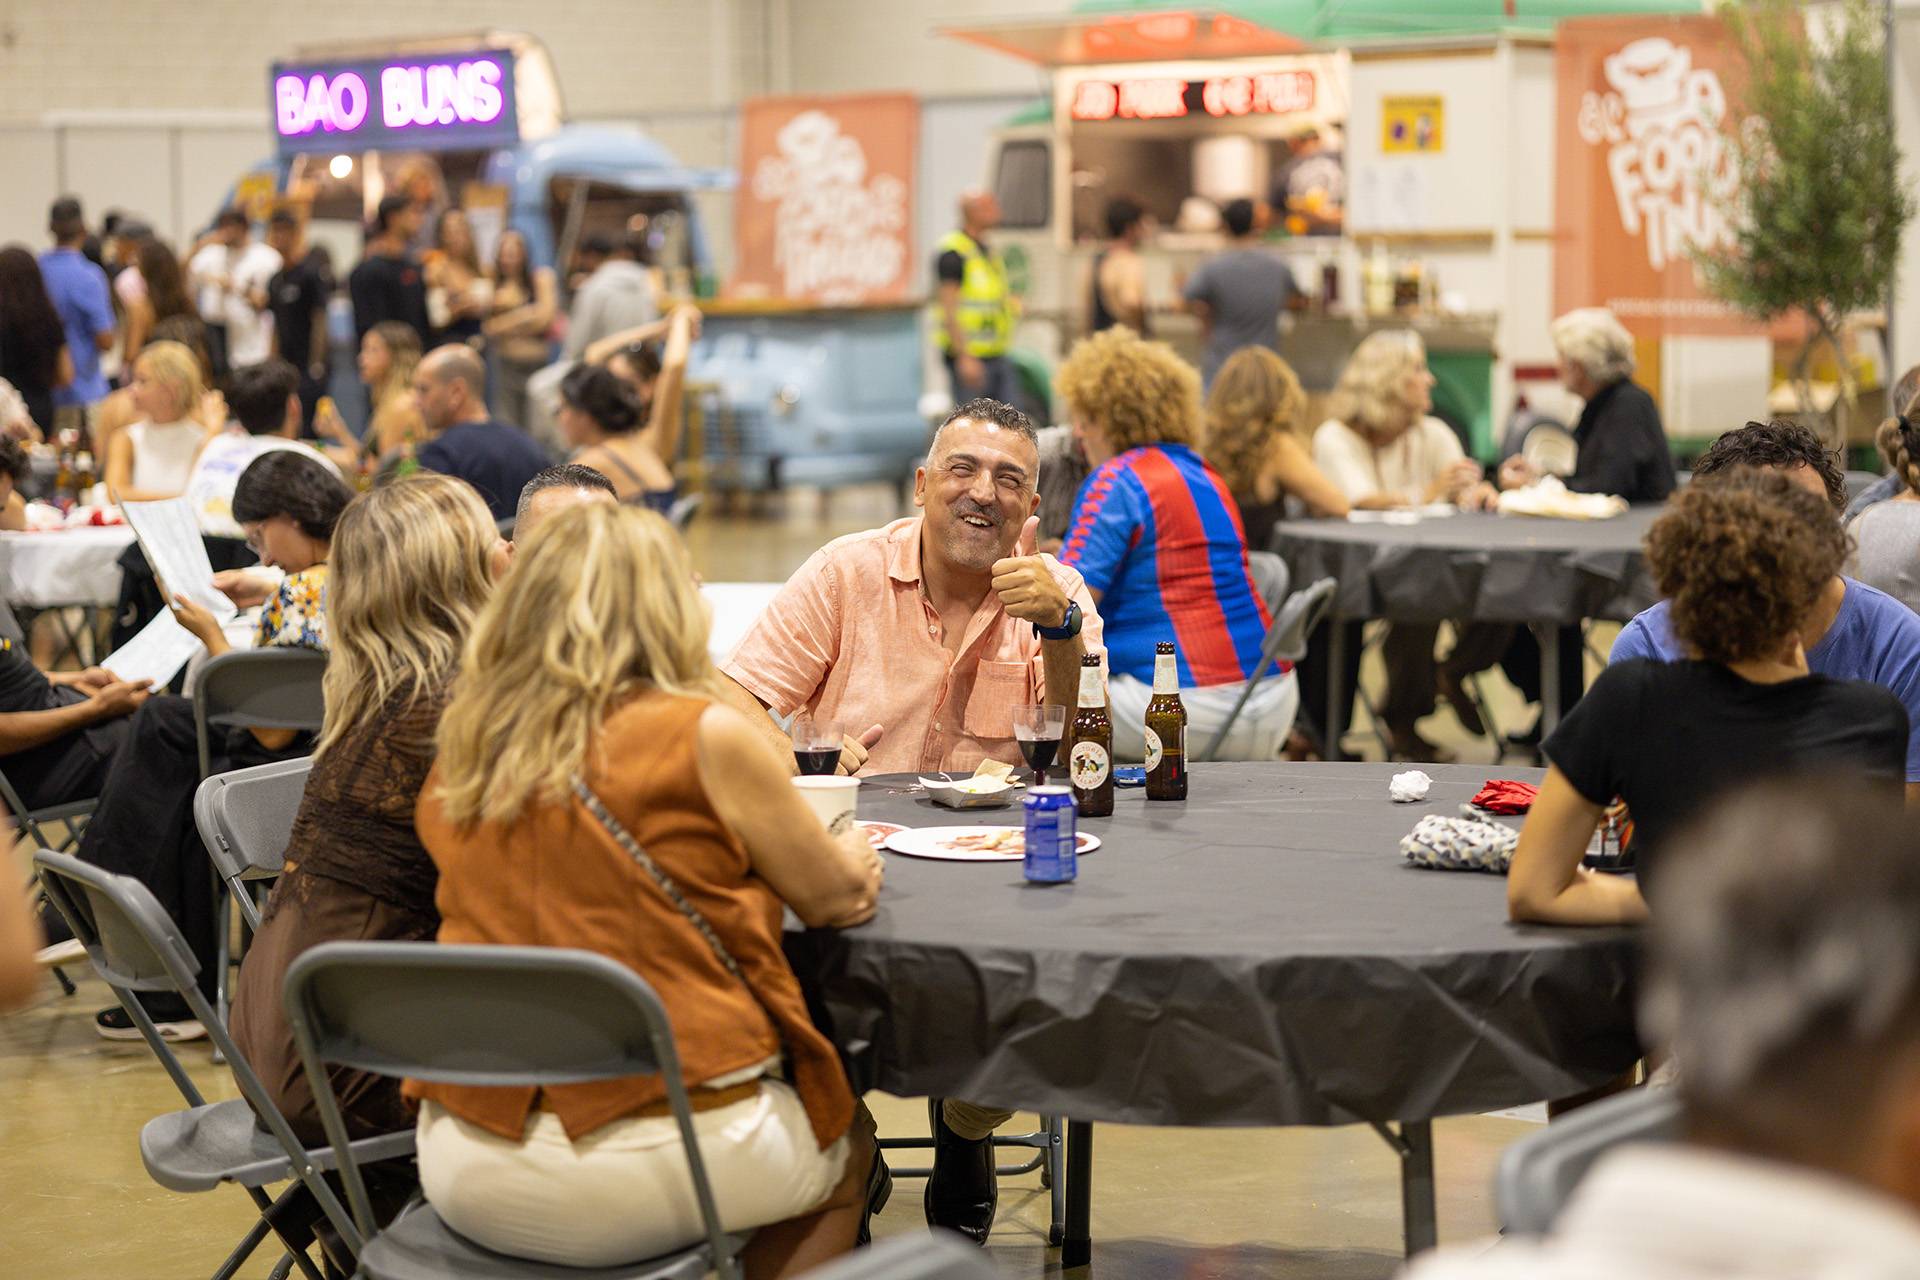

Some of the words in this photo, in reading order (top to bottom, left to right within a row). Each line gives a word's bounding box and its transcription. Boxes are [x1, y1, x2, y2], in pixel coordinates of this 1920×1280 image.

[275, 71, 368, 135] BAO
[381, 59, 503, 128] BUNS
[1607, 124, 1742, 235] FOOD
